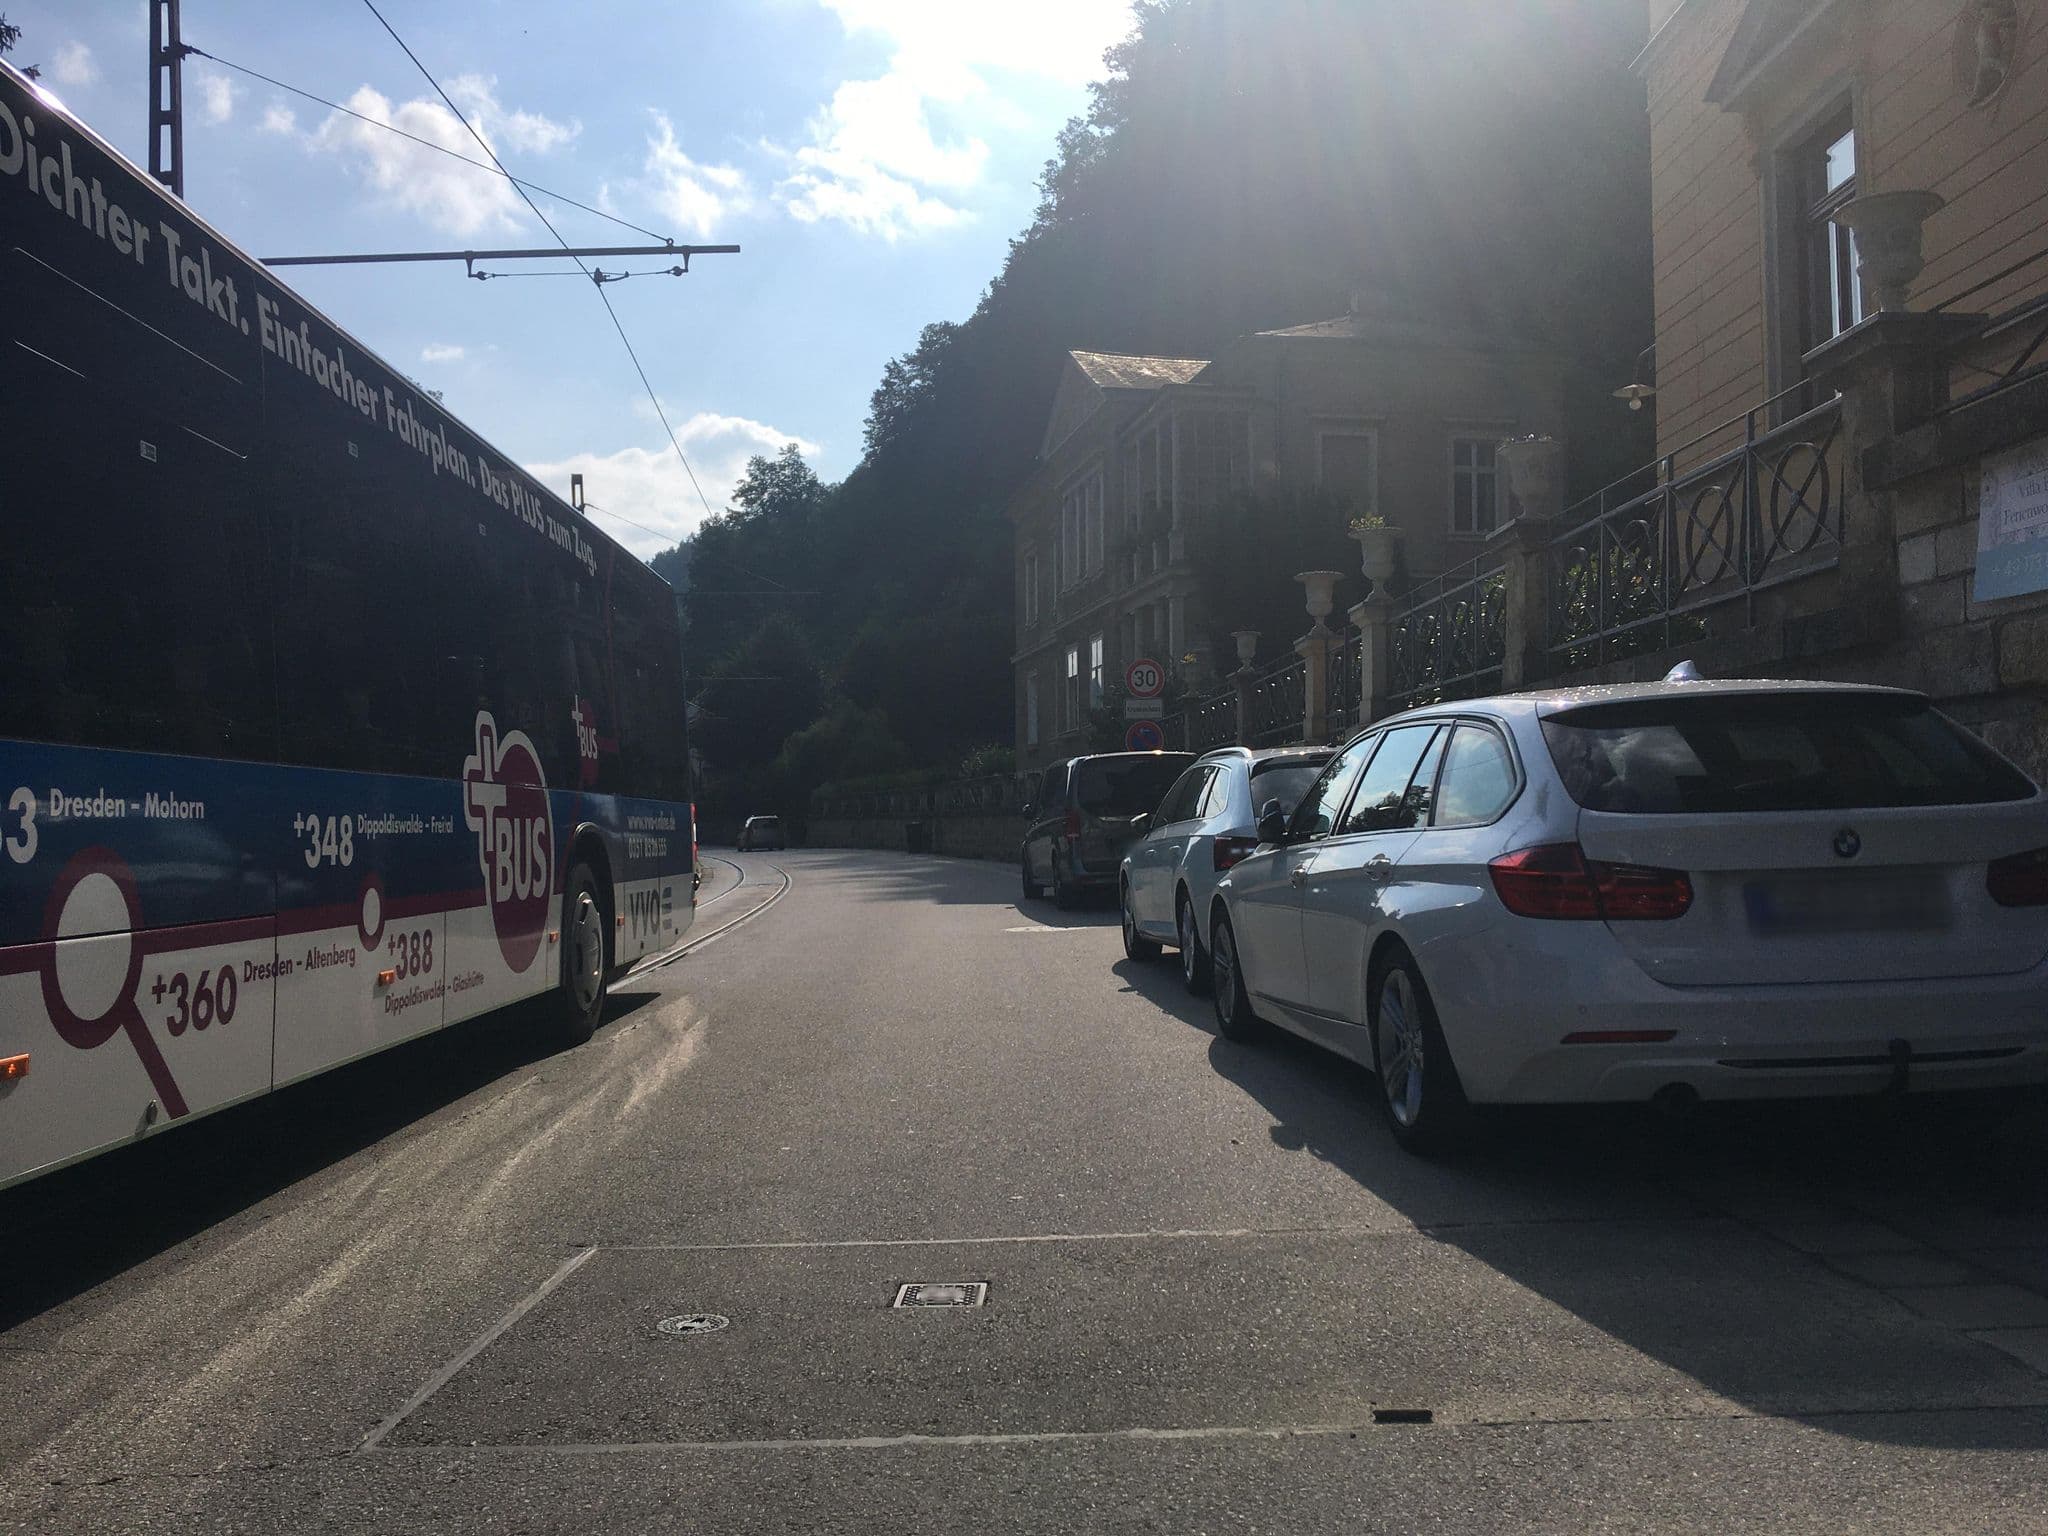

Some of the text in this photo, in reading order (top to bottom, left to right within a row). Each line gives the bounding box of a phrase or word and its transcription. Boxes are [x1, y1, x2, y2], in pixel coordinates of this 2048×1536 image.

[159, 221, 249, 336] Takt.
[256, 292, 379, 422] Einfacher
[383, 386, 476, 489] Fahrplan.
[478, 456, 510, 511] Das
[510, 480, 545, 534] PLUS
[547, 514, 572, 553] zum
[572, 525, 598, 577] Zug.
[1133, 670, 1156, 687] 30
[50, 787, 126, 818] Dresden
[144, 791, 205, 819] Mohorn
[293, 812, 354, 869] +348
[357, 813, 424, 840] Dippoldiswalde
[629, 889, 661, 941] VVO
[387, 928, 433, 980] +388
[151, 964, 238, 1037] +360
[243, 954, 293, 983] Dresden
[305, 944, 356, 971] Altenberg
[384, 978, 446, 1016] Dippoldiswalde
